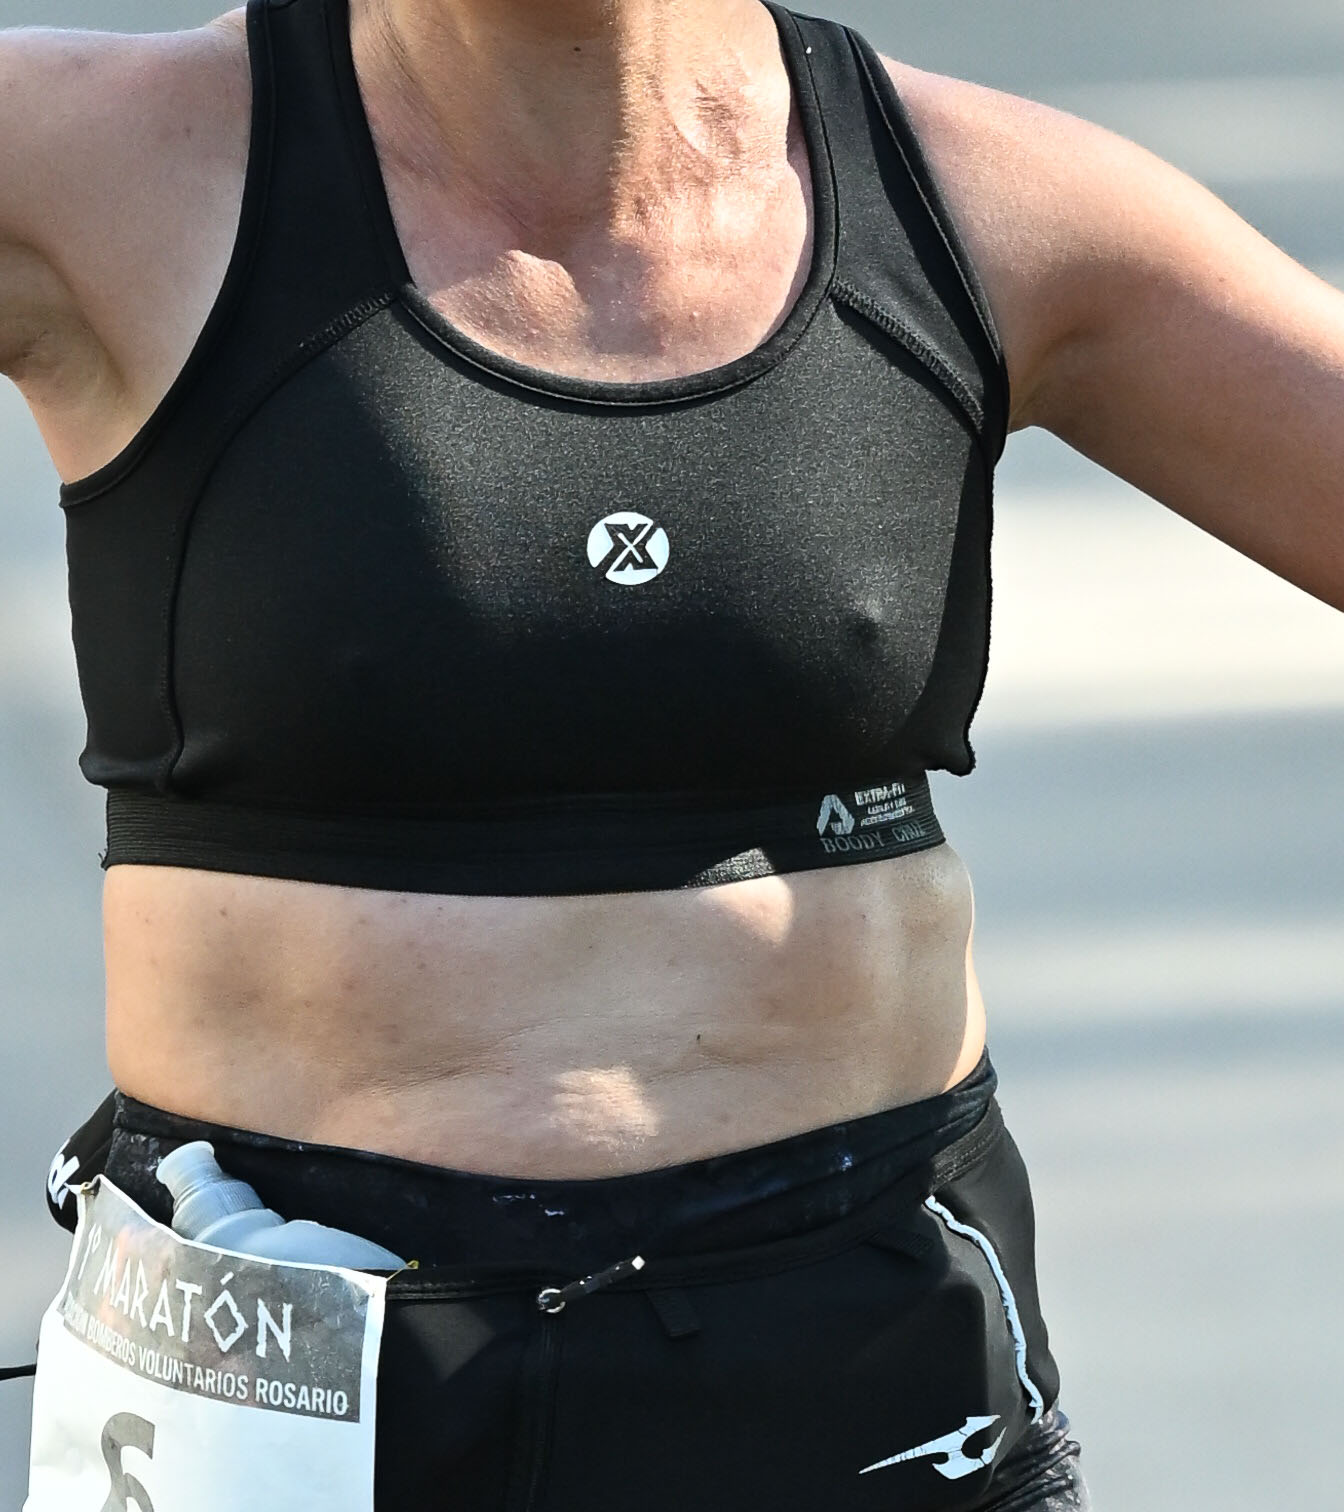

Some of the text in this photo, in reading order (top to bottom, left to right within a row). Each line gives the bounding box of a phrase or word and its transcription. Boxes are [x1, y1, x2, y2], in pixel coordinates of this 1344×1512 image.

[92, 1241, 293, 1363] MARATÓN
[87, 1315, 349, 1416] BOMBEROS VOLUNTARIOS ROSARIO
